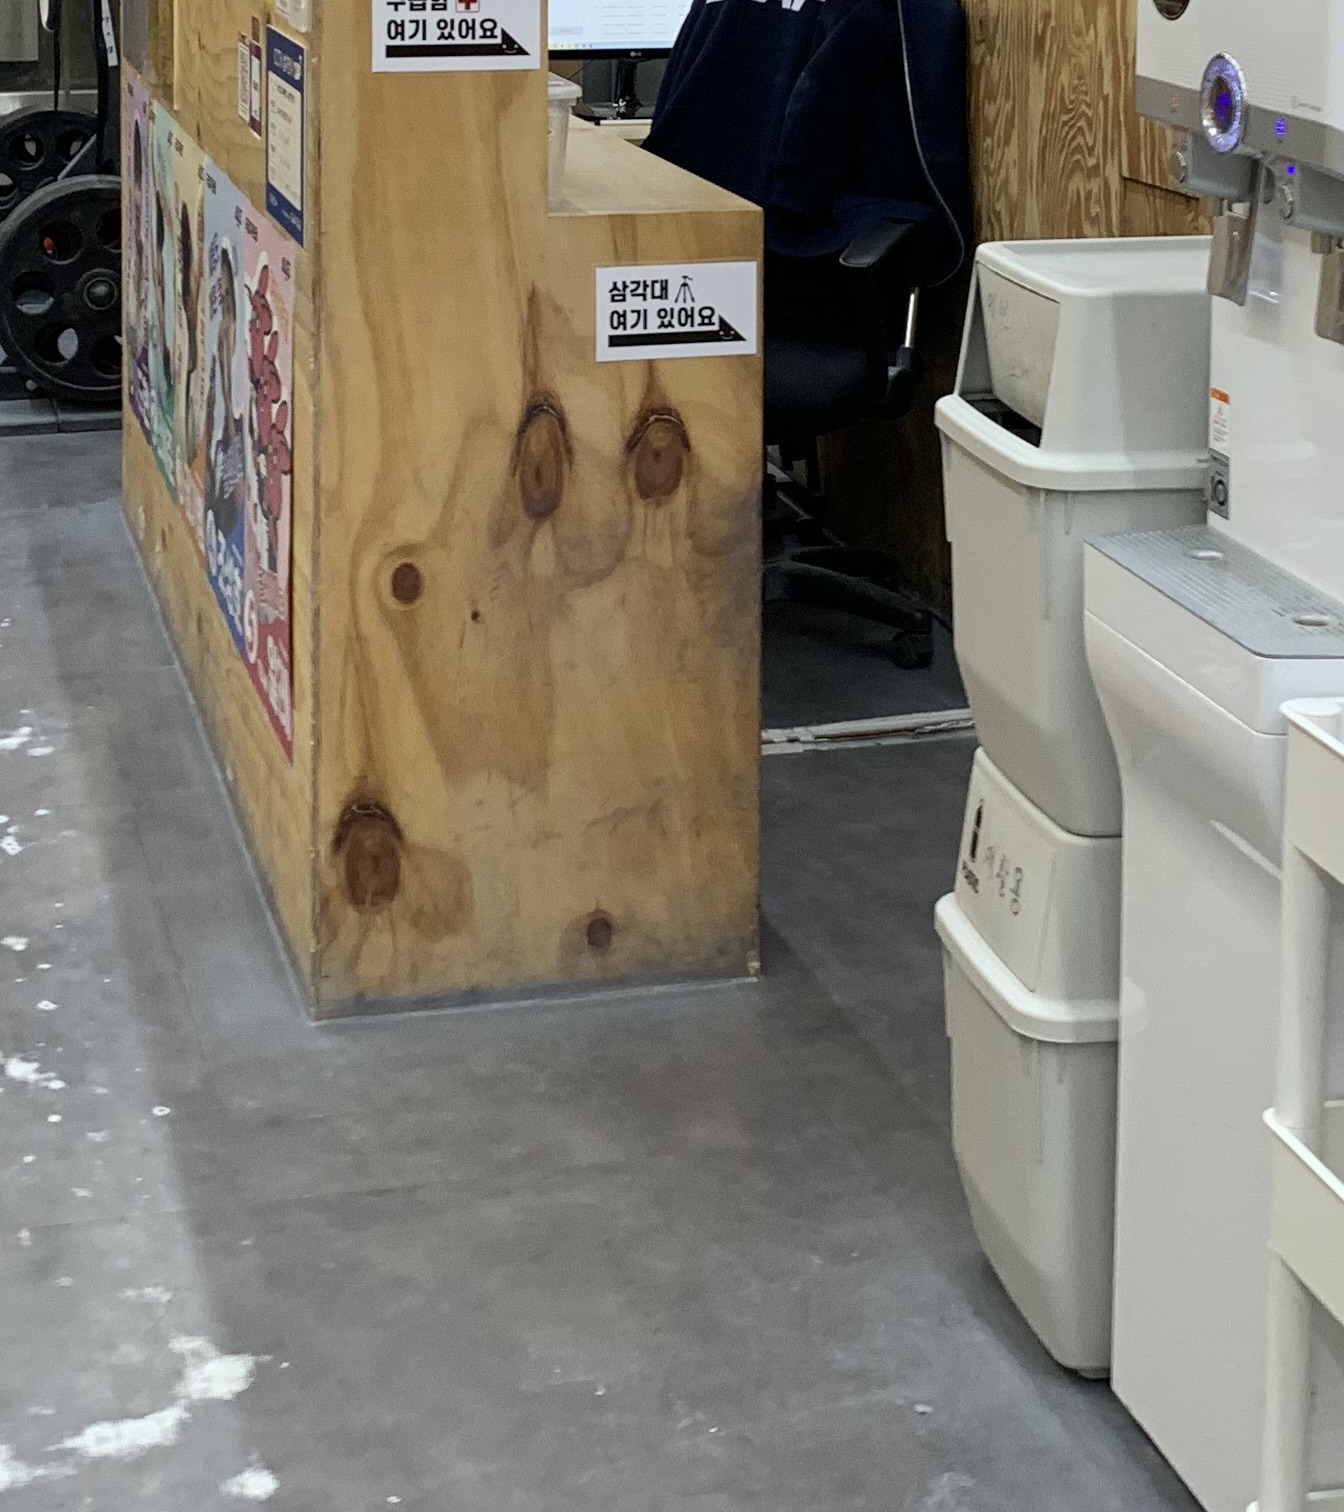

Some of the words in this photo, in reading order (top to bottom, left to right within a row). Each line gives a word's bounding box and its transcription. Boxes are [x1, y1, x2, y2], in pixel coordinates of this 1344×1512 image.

[387, 19, 427, 41] 여기
[436, 18, 498, 41] 있어요
[609, 279, 668, 303] 삼각대
[610, 309, 648, 331] 여기
[657, 306, 716, 329] 있어요
